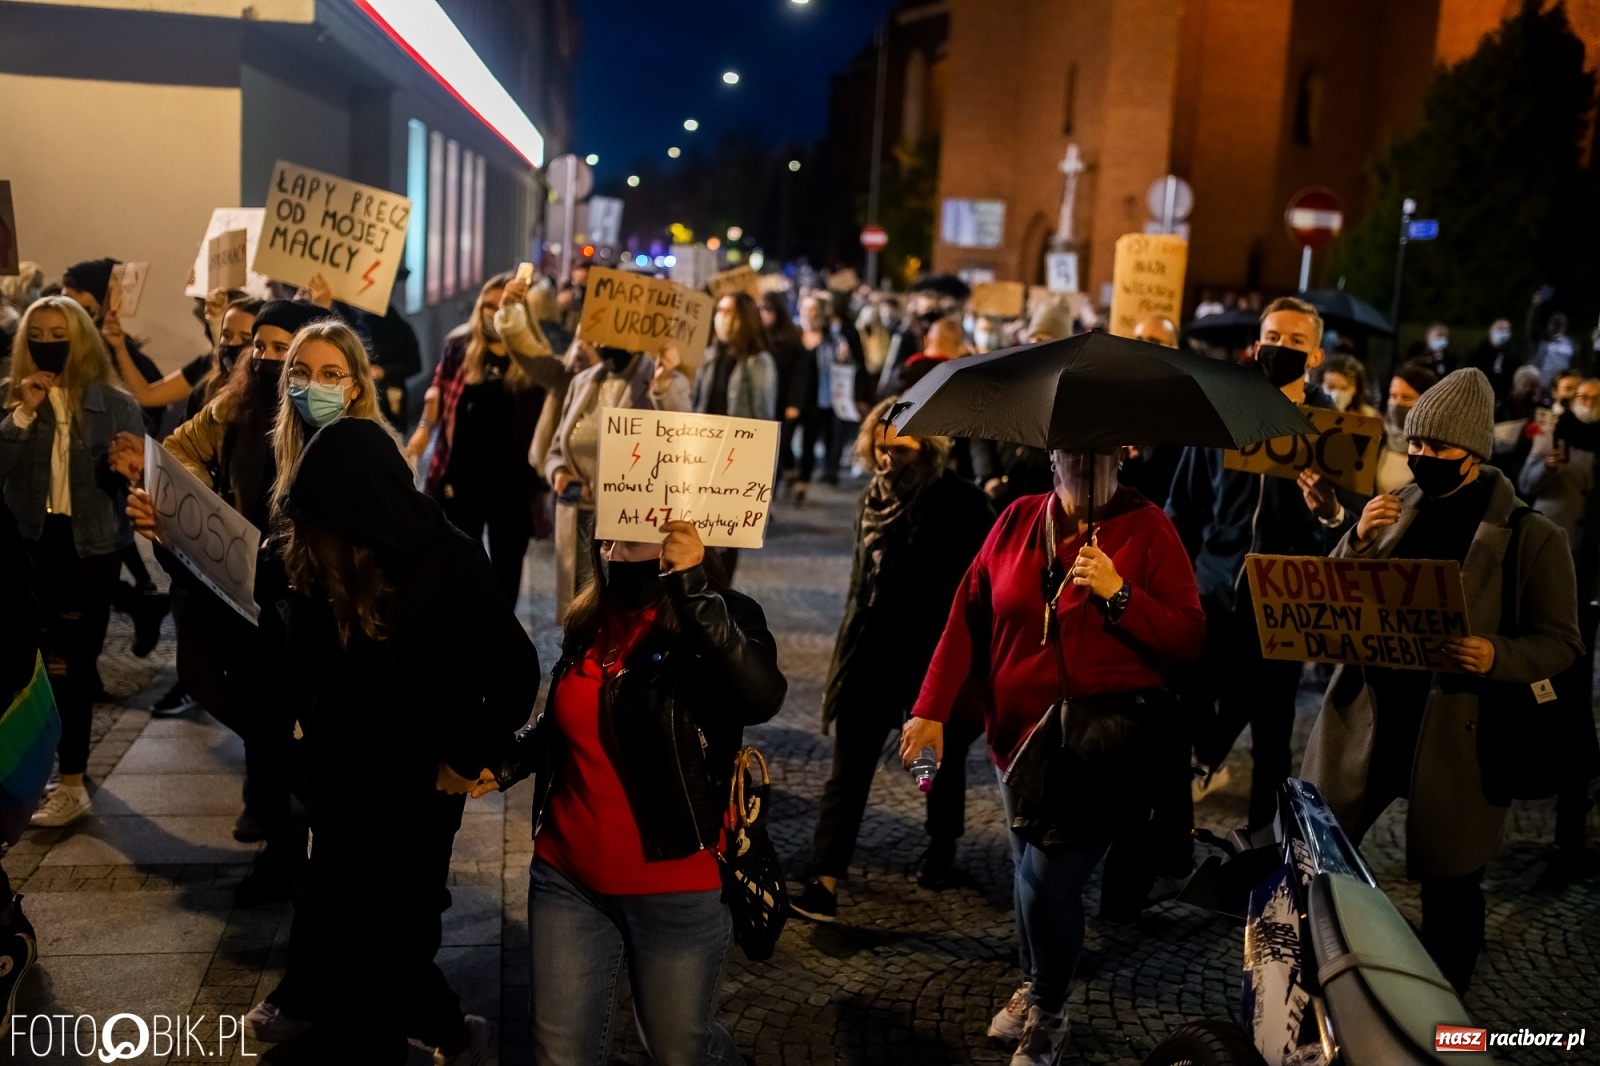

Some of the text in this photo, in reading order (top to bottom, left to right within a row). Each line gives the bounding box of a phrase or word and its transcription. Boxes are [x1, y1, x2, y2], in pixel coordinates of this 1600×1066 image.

[276, 169, 410, 232] ŁAPY PRECZ
[276, 198, 390, 253] OD MOJEJ
[269, 224, 360, 274] MACICY
[607, 415, 757, 443] NIE będziesz mi
[603, 473, 654, 493] mówić
[664, 481, 693, 506] jak
[698, 484, 740, 496] mam
[645, 507, 674, 527] 47
[742, 510, 763, 528] RP
[1377, 607, 1467, 637] RAZEM
[1303, 632, 1360, 661] DLA
[1361, 633, 1444, 668] SIEBIE
